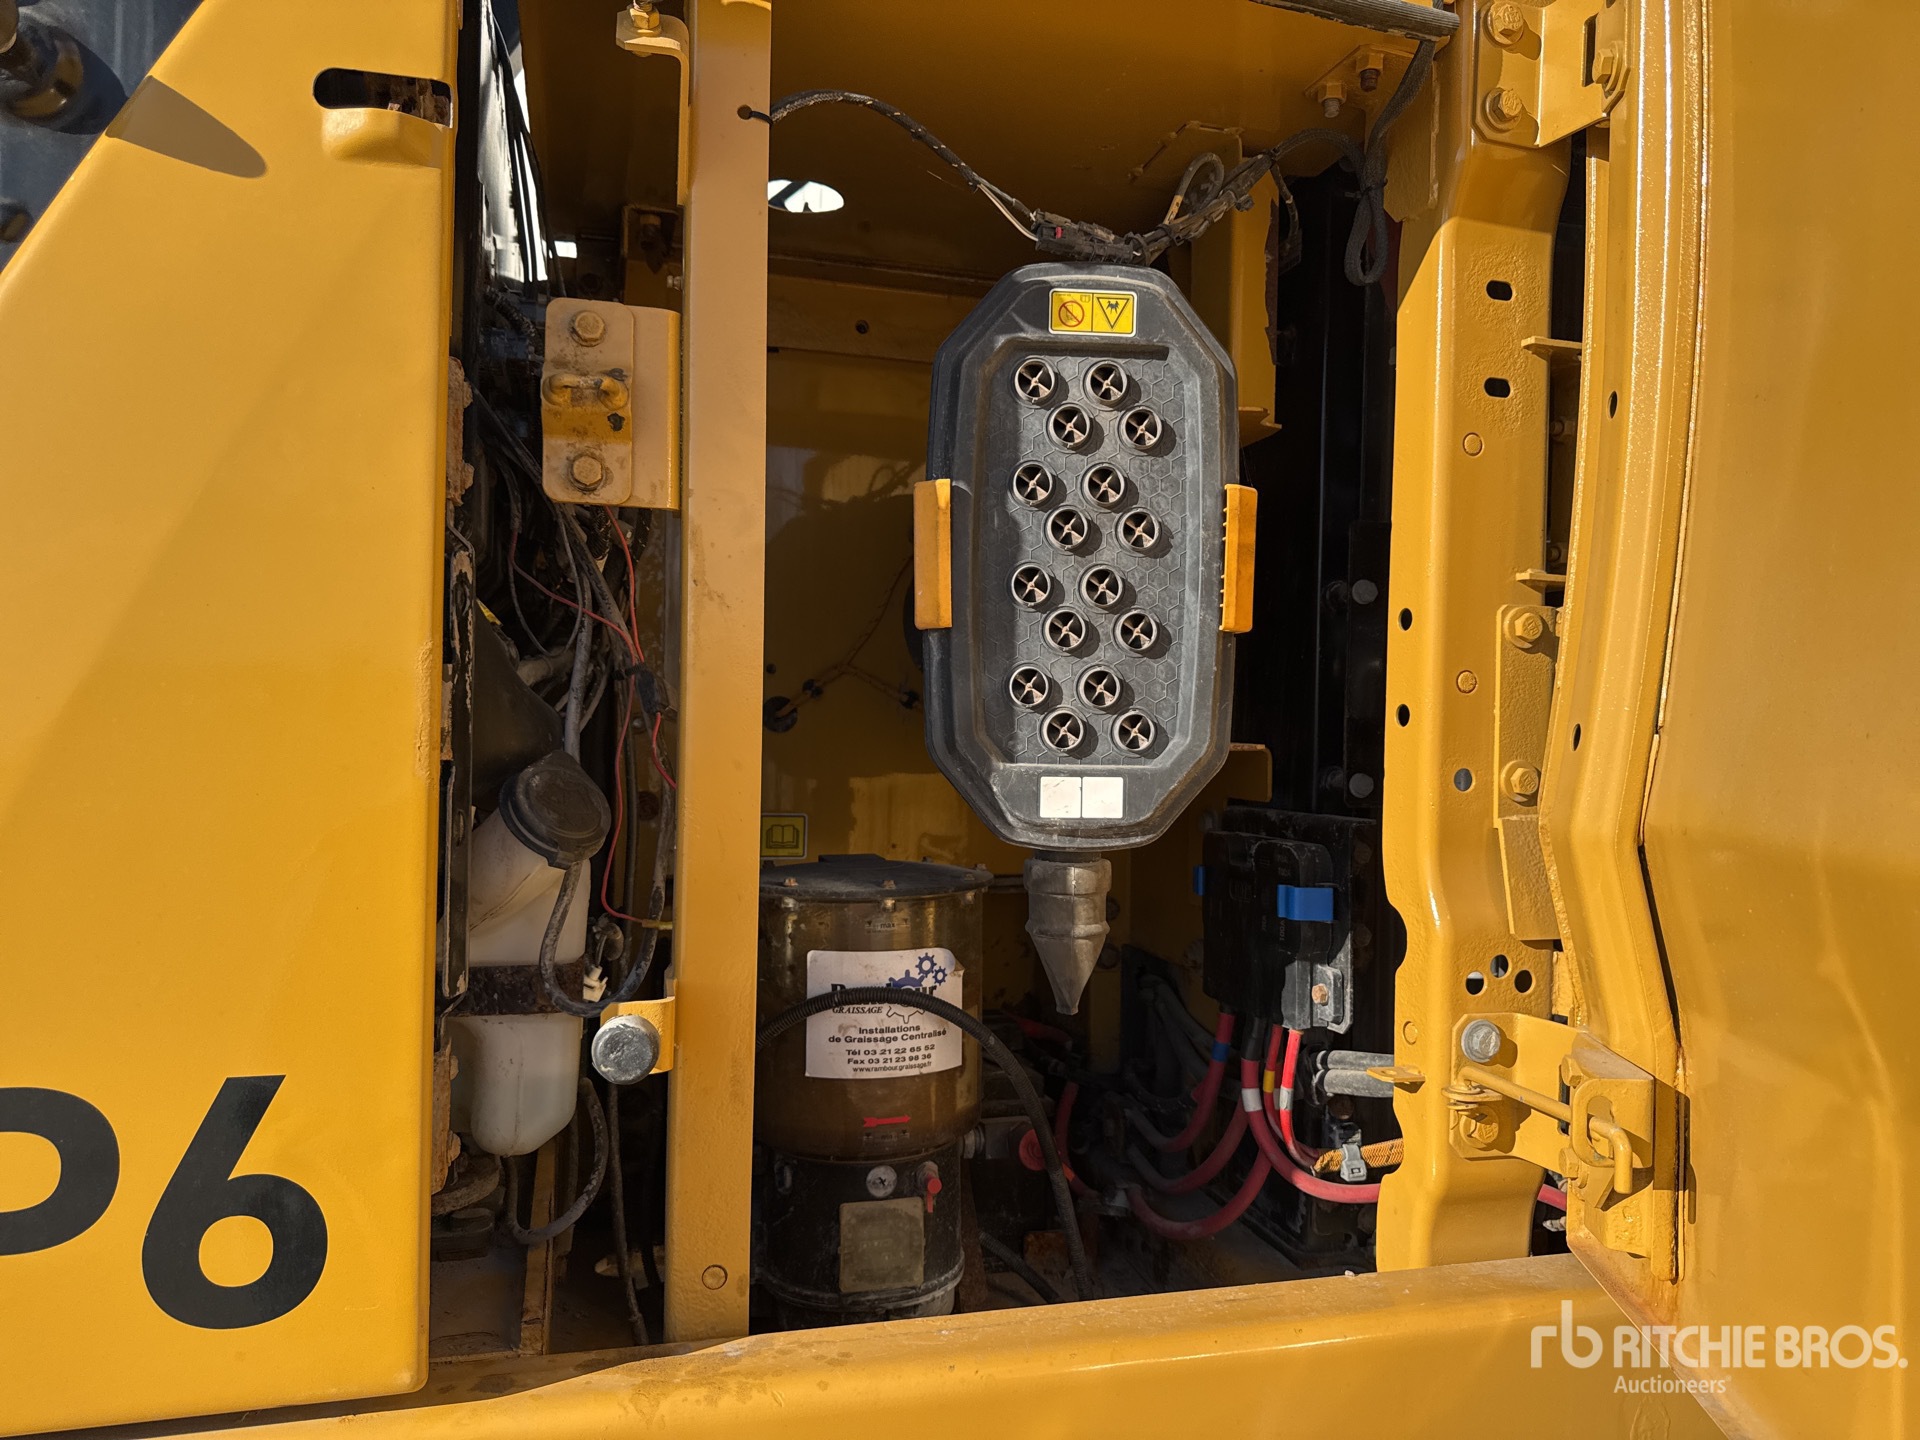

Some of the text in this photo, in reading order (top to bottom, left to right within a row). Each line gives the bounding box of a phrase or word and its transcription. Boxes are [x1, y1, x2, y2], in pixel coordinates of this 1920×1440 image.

[832, 1006, 883, 1014] GRAISSAGE
[859, 1025, 921, 1035] Installations
[828, 1028, 947, 1044] de Graissage Centralisé
